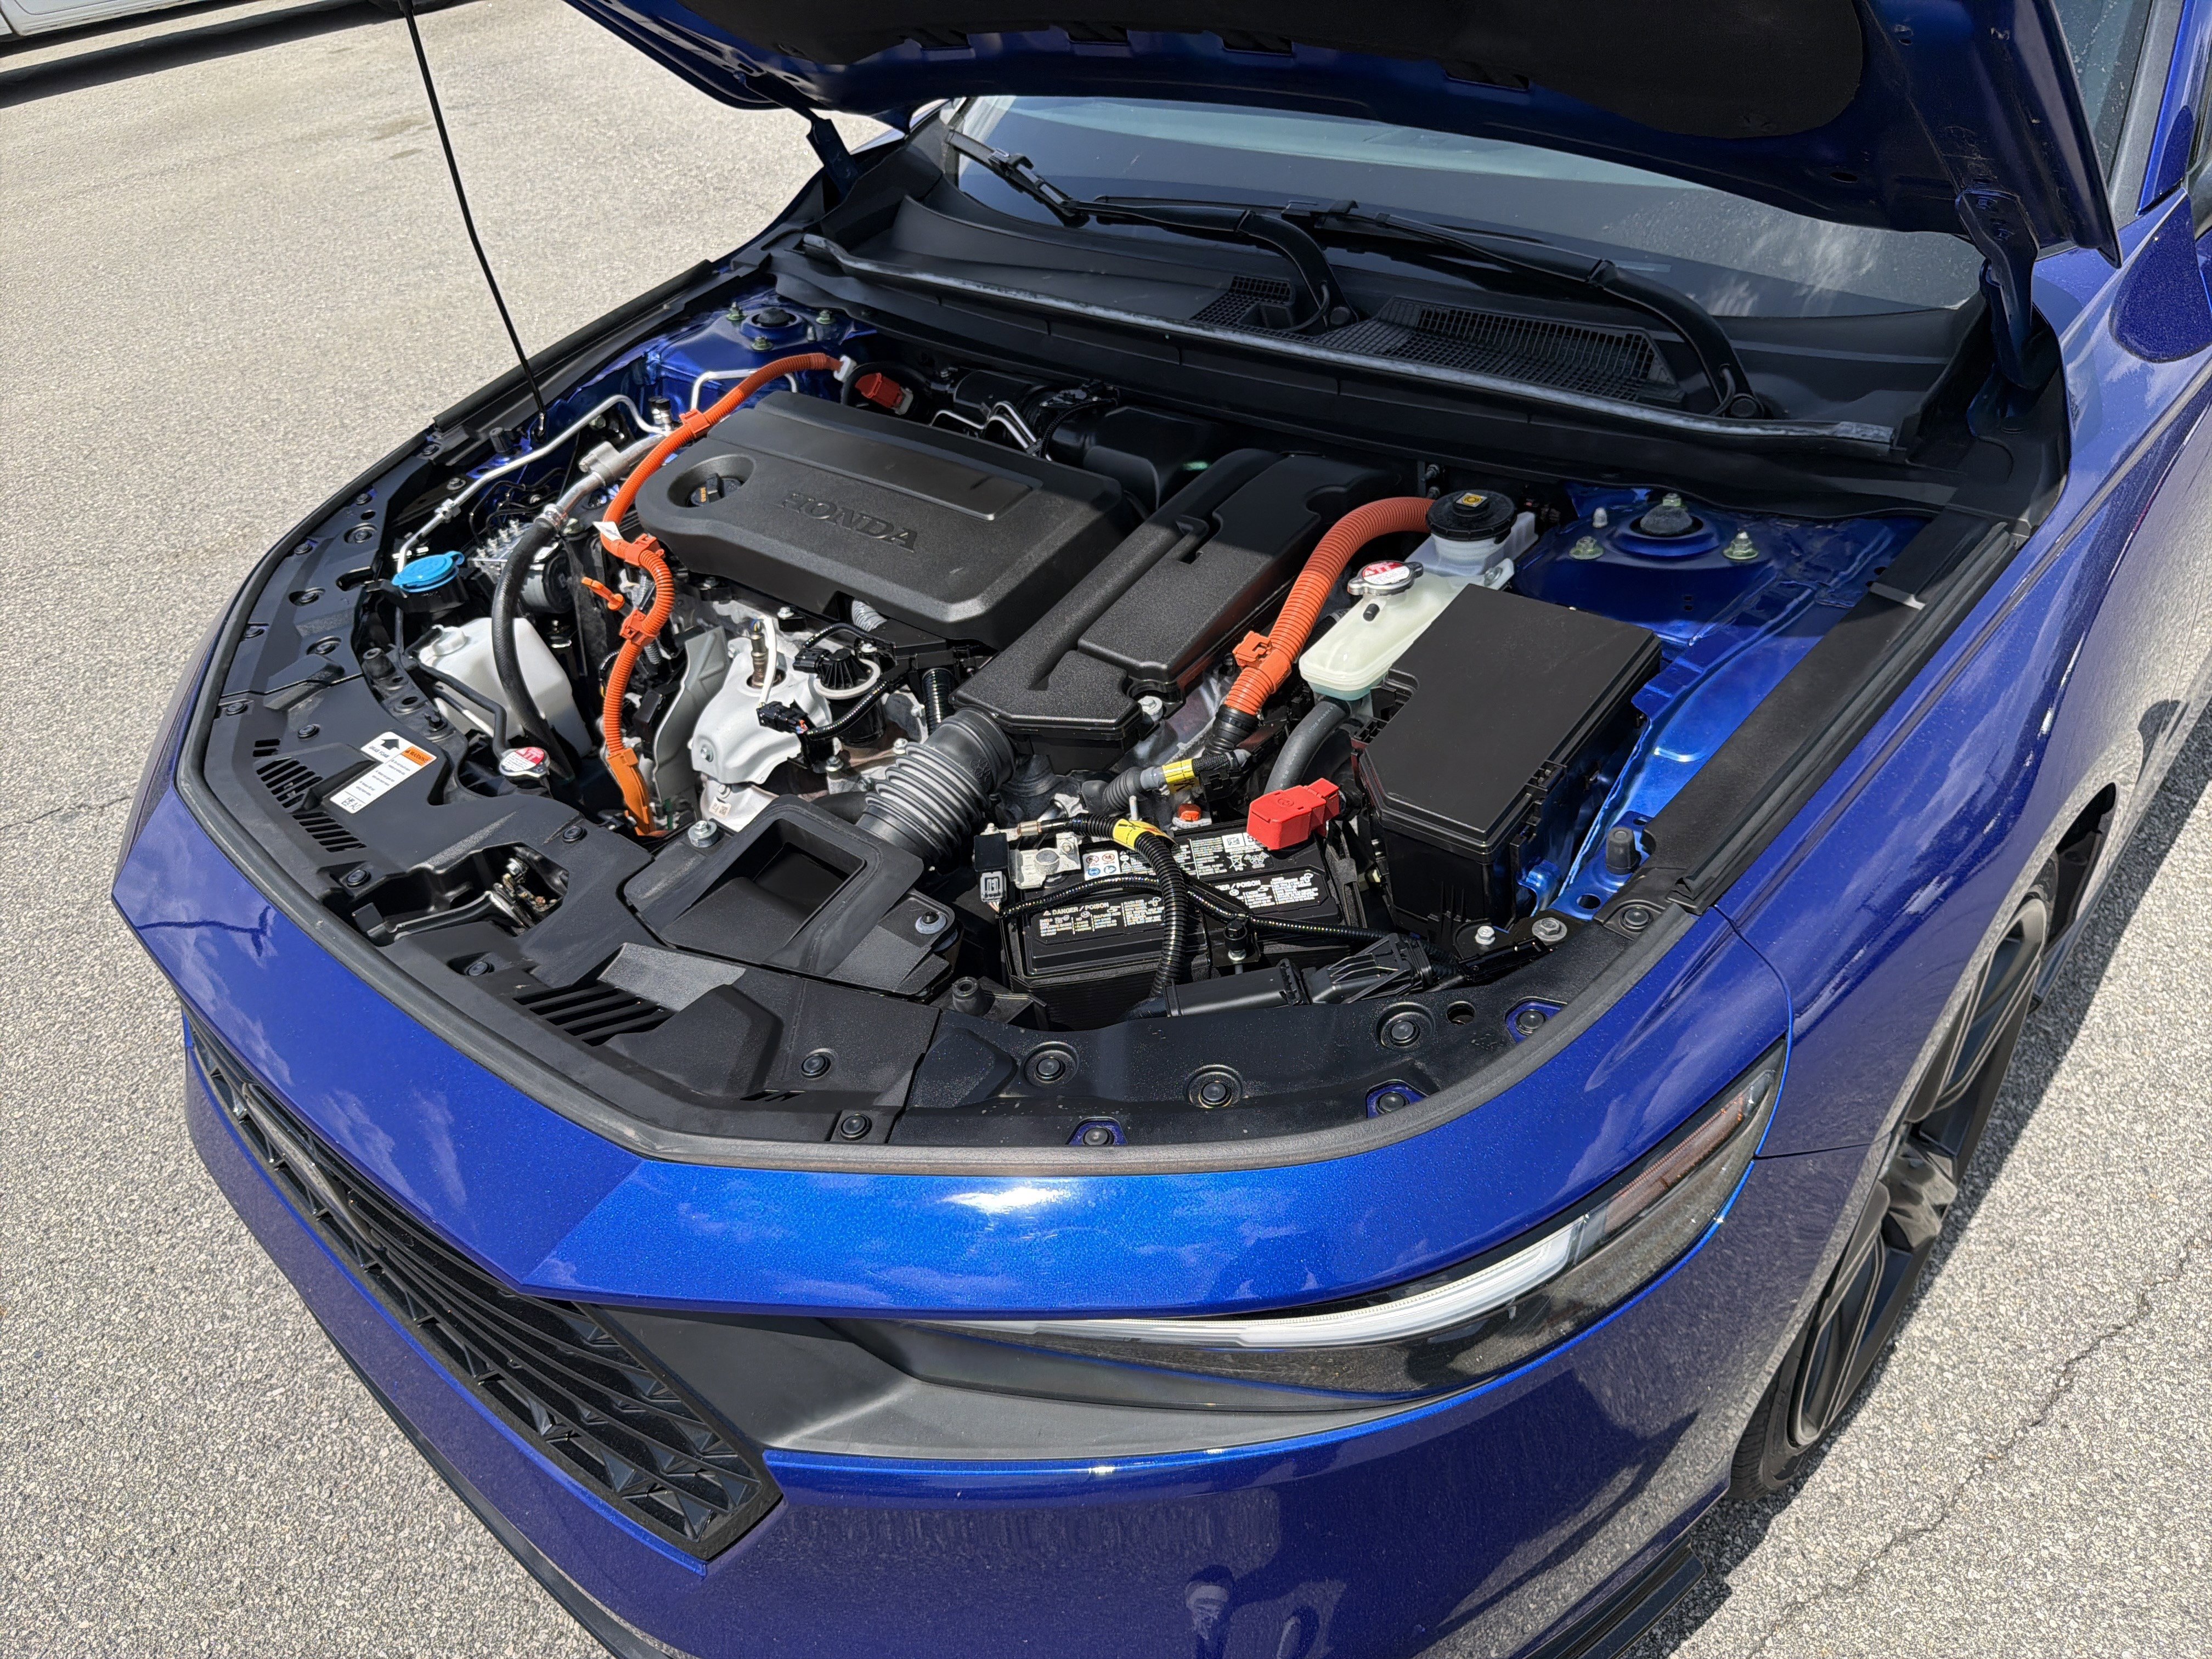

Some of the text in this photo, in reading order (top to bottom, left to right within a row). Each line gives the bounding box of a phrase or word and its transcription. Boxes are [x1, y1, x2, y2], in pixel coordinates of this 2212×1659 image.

[774, 493, 918, 552] HONDA
[1236, 879, 1261, 889] POISON
[1052, 906, 1079, 915] DANGER
[1085, 902, 1109, 911] POISON
